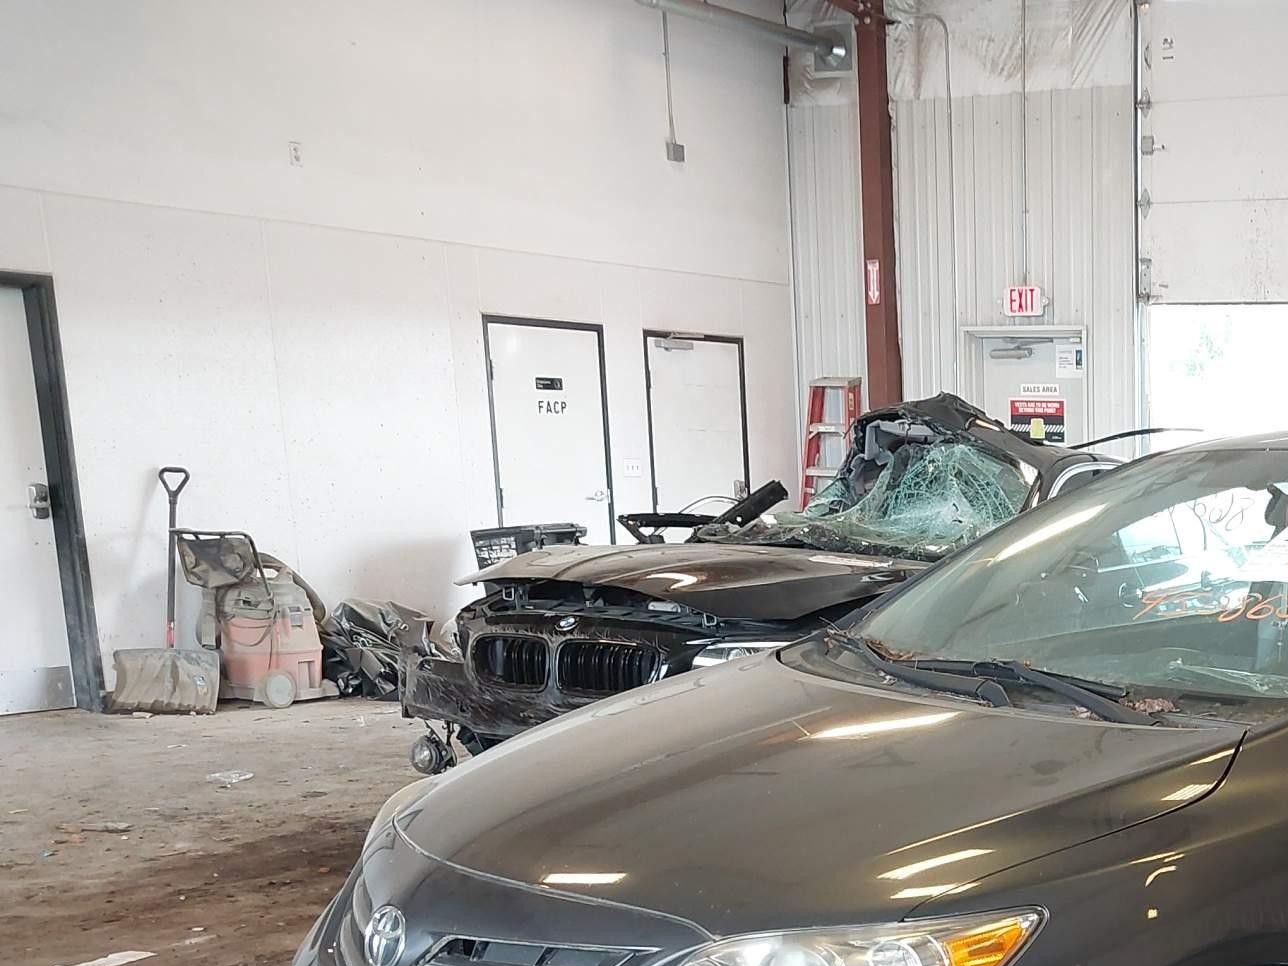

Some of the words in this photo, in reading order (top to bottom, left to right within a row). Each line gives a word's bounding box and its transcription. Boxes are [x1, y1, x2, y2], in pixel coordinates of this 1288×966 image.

[1009, 288, 1035, 313] EXIT
[1022, 385, 1041, 393] SALES
[1042, 385, 1058, 393] AREA
[538, 400, 567, 414] FACP
